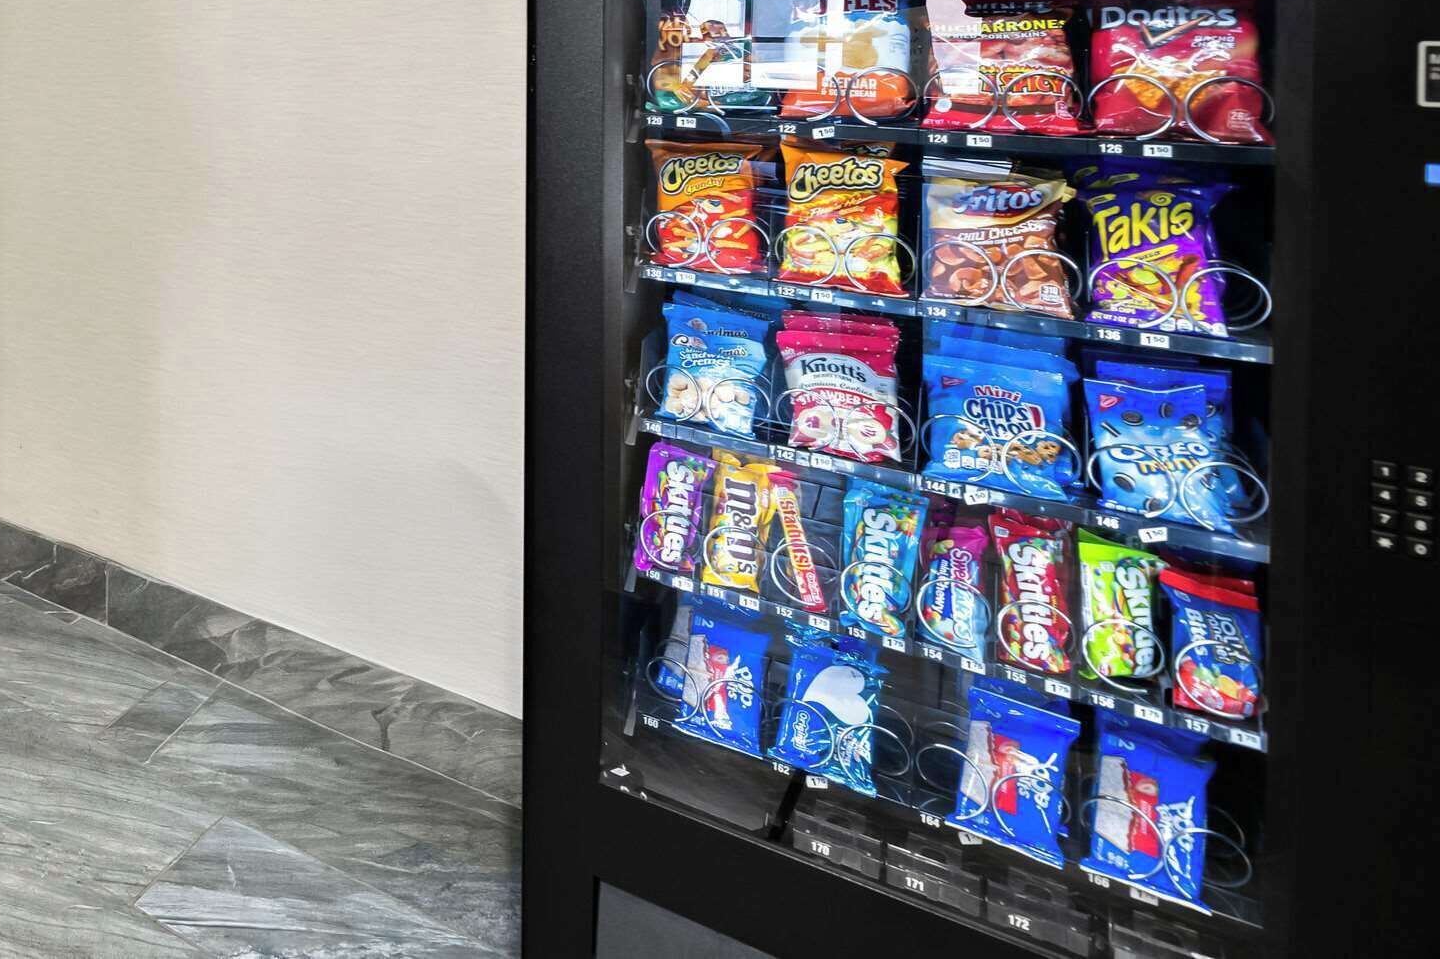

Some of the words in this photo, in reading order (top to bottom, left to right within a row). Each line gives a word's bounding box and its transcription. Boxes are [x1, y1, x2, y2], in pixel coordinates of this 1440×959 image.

[1100, 6, 1238, 30] Doritos
[1013, 30, 1048, 39] SKINS
[778, 124, 796, 134] 122
[927, 134, 948, 143] 124
[1098, 143, 1123, 154] 126
[661, 153, 741, 194] Cheetos
[788, 157, 883, 203] Cheetos
[952, 185, 1043, 214] Fritos
[1093, 193, 1195, 263] Takis
[958, 232, 986, 242] CHILI
[777, 287, 796, 297] 132
[926, 306, 947, 317] 134
[1097, 328, 1121, 340] 136
[682, 358, 732, 368] Cremes
[801, 357, 867, 383] Knott's
[975, 385, 1021, 402] Mini
[965, 399, 1028, 422] Chips
[776, 449, 795, 460] 142
[1109, 441, 1210, 462] OREO
[1138, 457, 1201, 475] mini
[1381, 466, 1390, 477] 1
[1415, 471, 1428, 483] 2
[926, 480, 946, 492] 144
[1379, 489, 1391, 500] 4
[660, 461, 695, 564] Skittles
[1379, 512, 1391, 524] 7
[778, 498, 813, 571] Starburst
[1413, 543, 1428, 555] 0
[857, 508, 897, 620] Skittles
[645, 570, 660, 579] 150
[1009, 542, 1054, 661] Skittles
[776, 606, 793, 618] 152
[1116, 565, 1155, 676] Skittles
[847, 626, 866, 639] 153
[923, 647, 943, 660] 154
[1006, 670, 1027, 684] 155
[1091, 694, 1115, 709] 156
[643, 716, 659, 728] 160
[1185, 718, 1210, 733] 157
[772, 761, 791, 775] 162
[919, 813, 941, 829] 164
[810, 840, 831, 857] 170
[905, 877, 925, 892] 171
[1087, 872, 1111, 889] 166
[1007, 914, 1031, 931] 172
